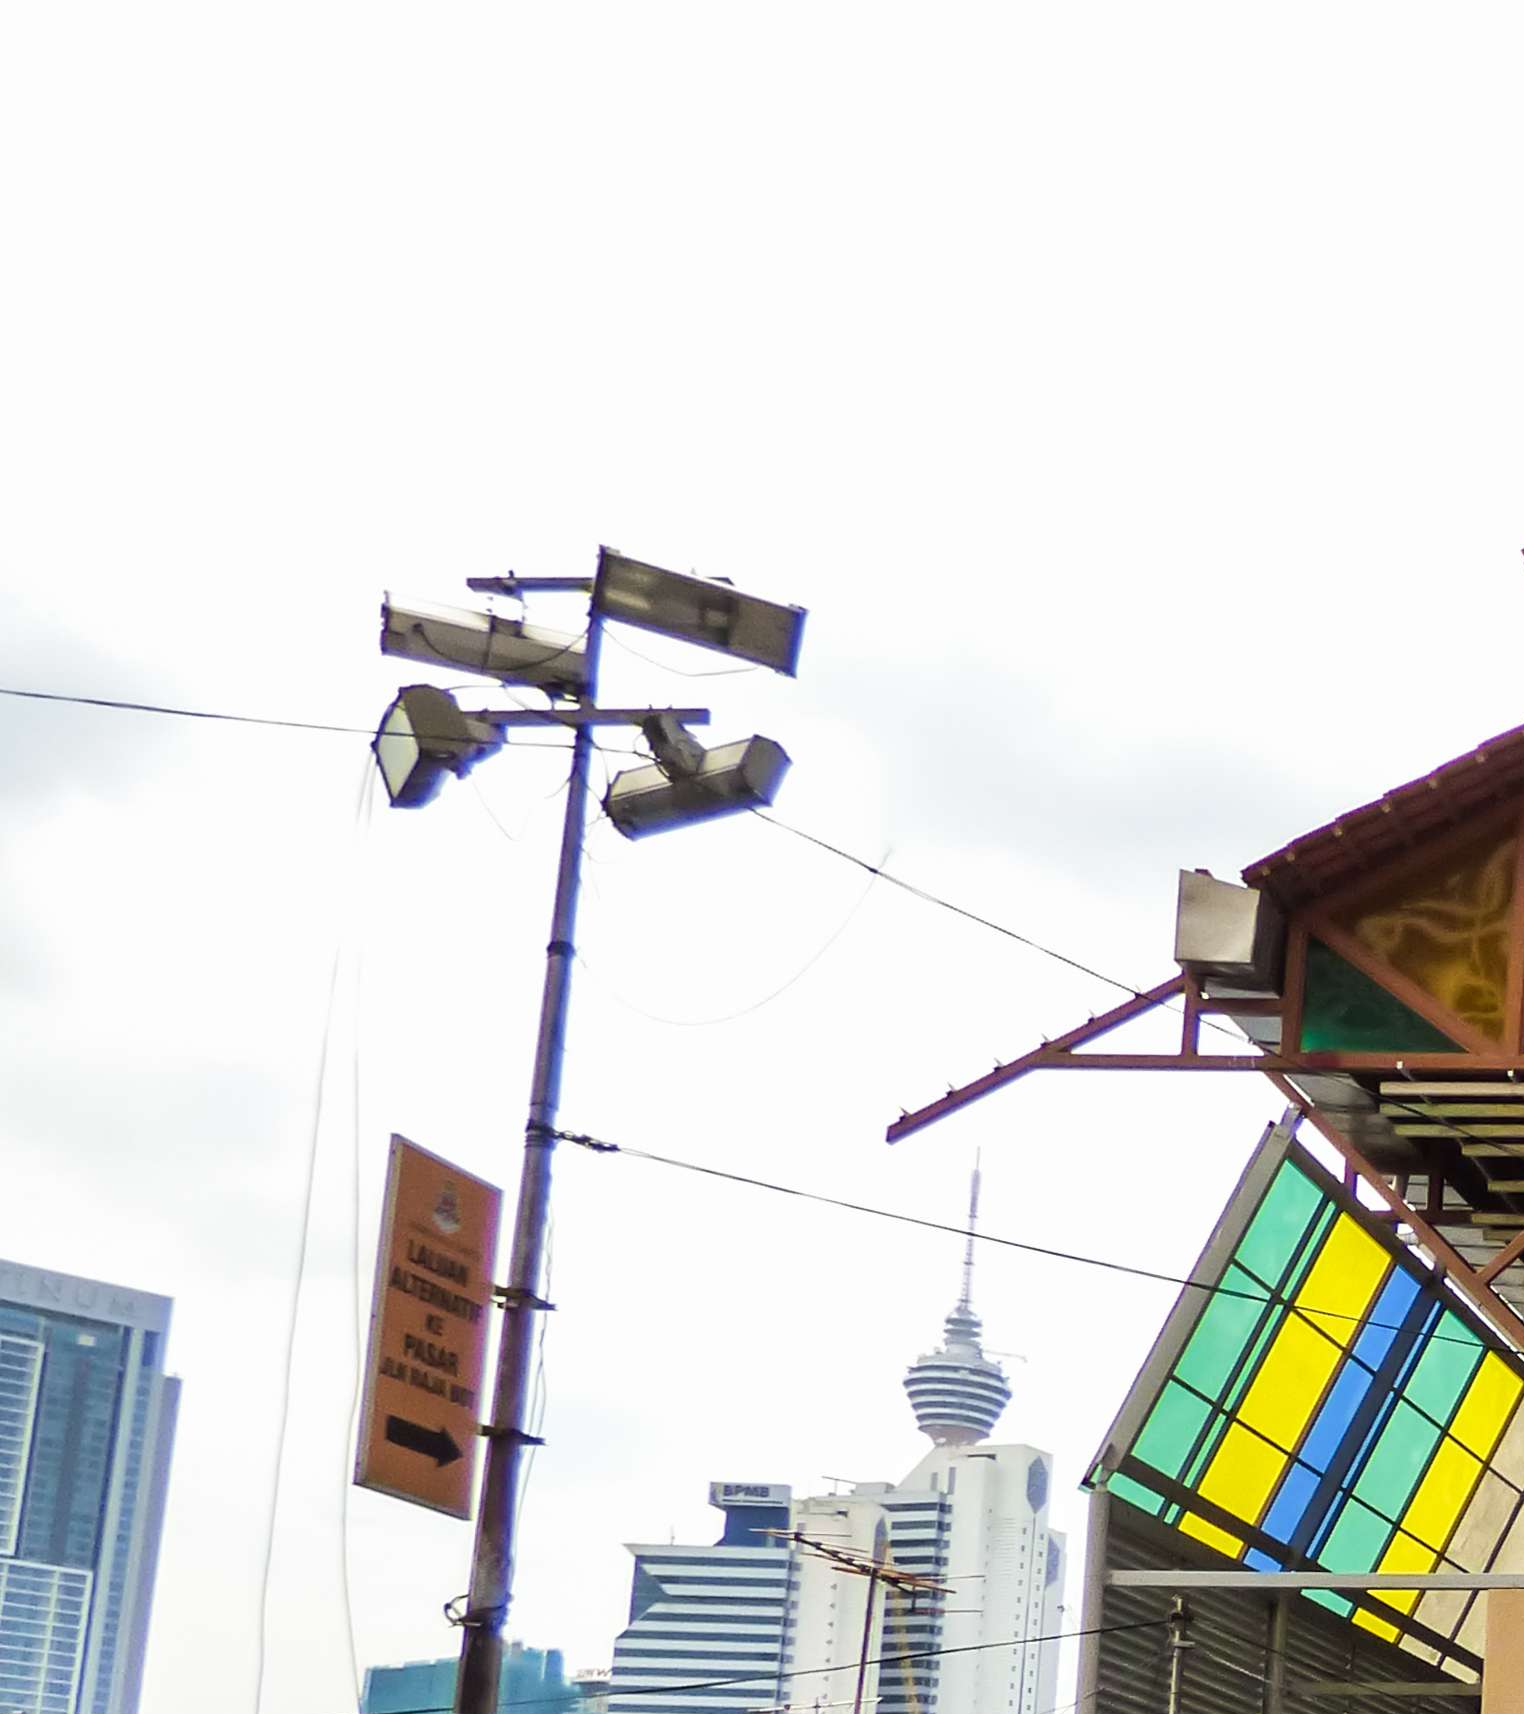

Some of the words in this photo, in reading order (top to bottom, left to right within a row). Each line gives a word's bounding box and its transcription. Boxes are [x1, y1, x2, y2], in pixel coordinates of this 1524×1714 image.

[388, 1266, 484, 1324] ALTERNATIF
[426, 1313, 445, 1337] KE
[404, 1333, 460, 1377] PASAR
